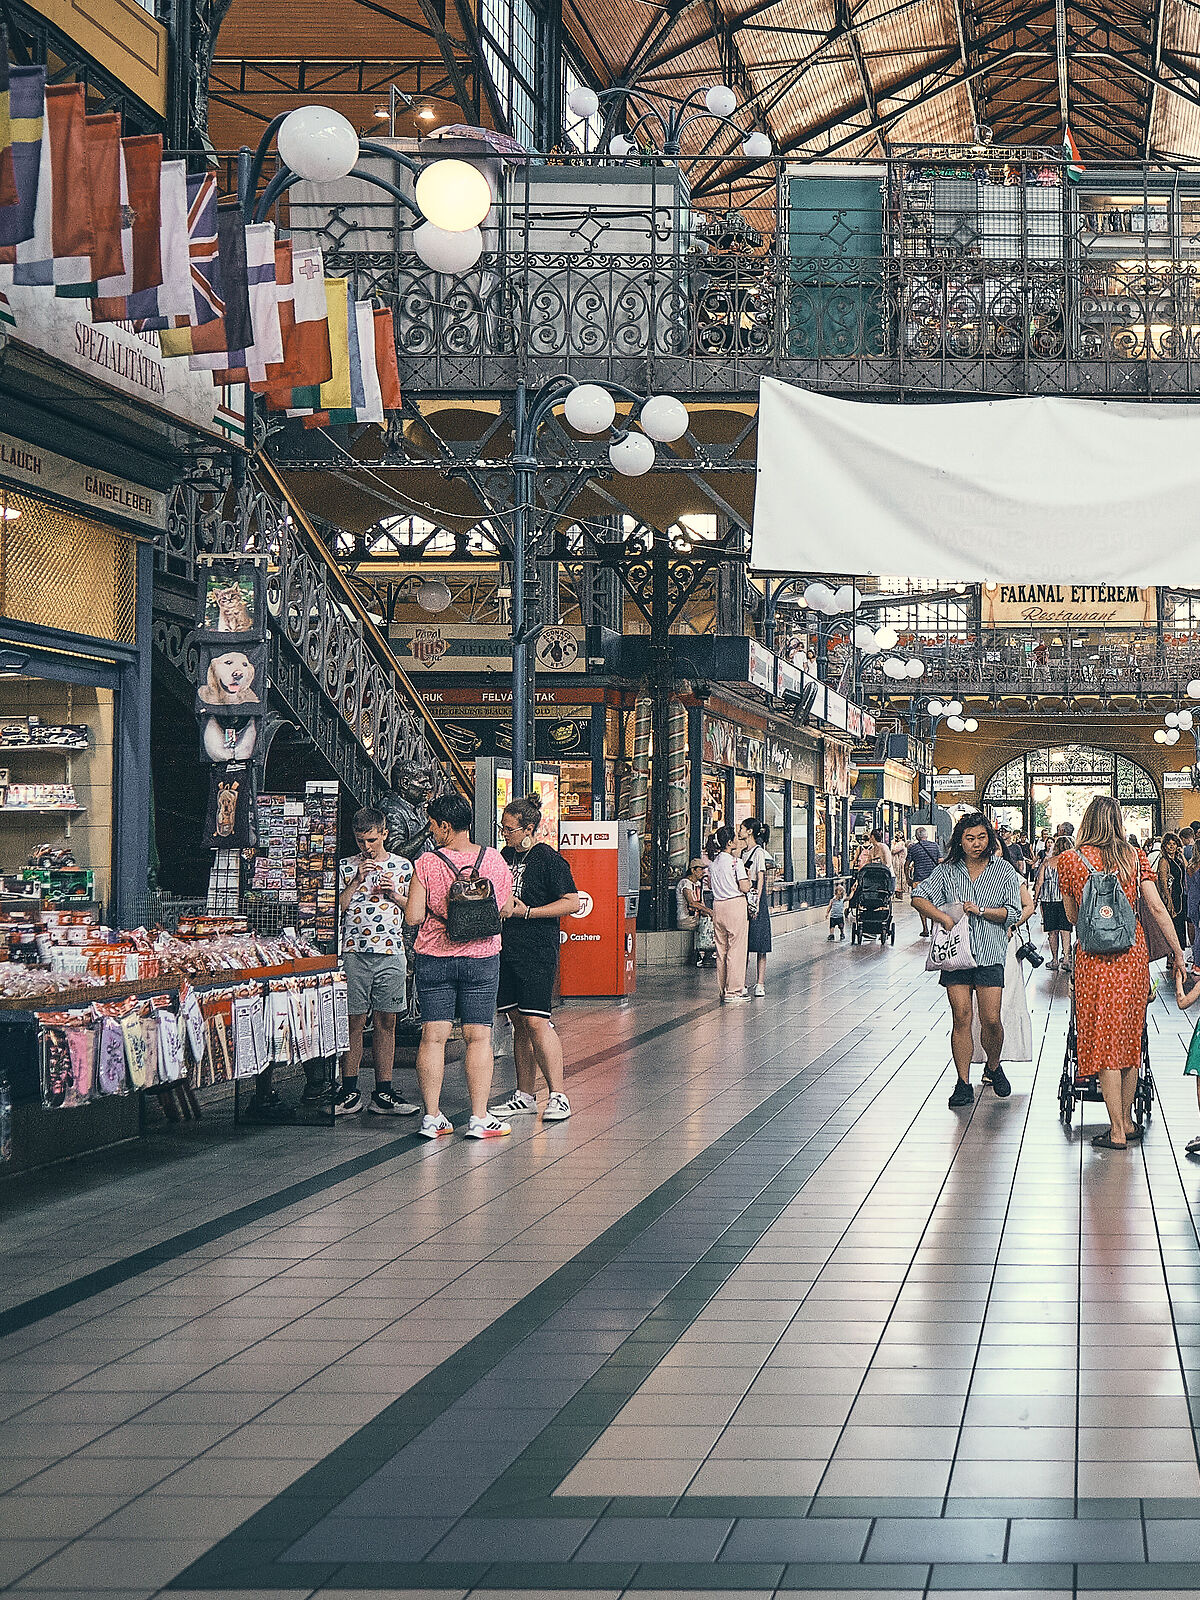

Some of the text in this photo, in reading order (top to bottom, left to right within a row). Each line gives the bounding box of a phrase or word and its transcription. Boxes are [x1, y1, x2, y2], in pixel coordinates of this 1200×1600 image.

[75, 321, 166, 395] SPEZIALITÄTEN
[1020, 606, 1117, 621] Restaurant
[482, 689, 555, 702] FELVÁTAK
[534, 707, 550, 715] OLD
[560, 834, 593, 846] ATM
